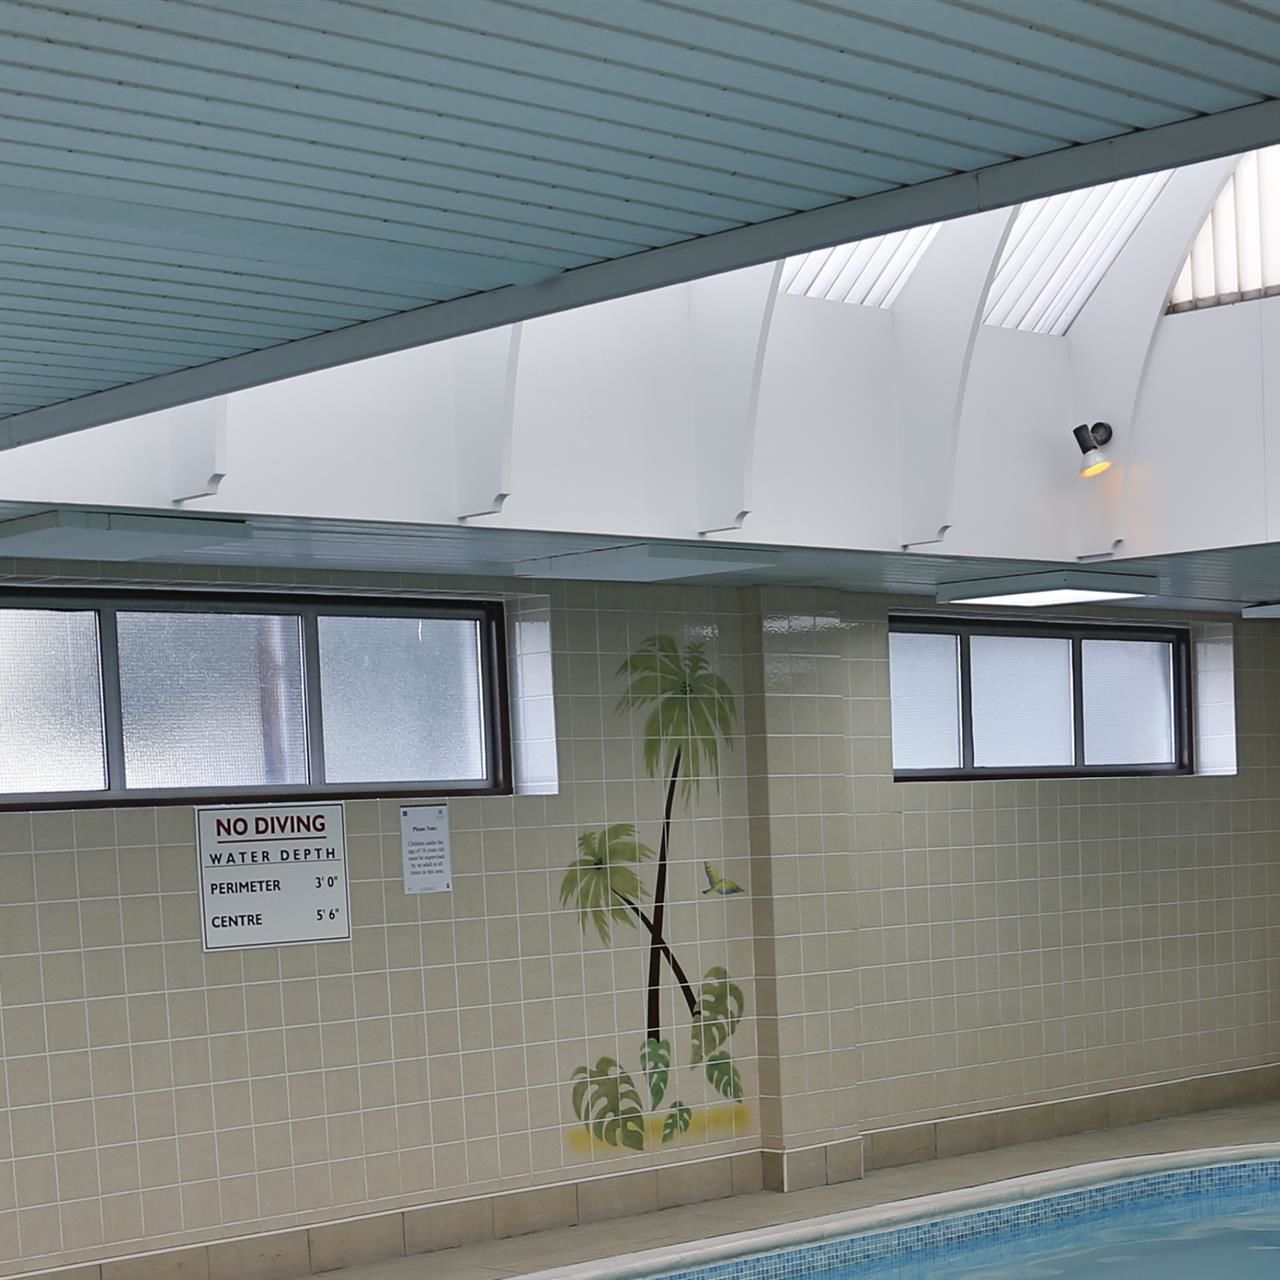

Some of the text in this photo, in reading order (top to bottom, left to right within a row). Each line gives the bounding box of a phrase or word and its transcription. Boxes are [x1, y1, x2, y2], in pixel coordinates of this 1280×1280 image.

[216, 814, 326, 836] NO DIVING
[209, 848, 335, 865] WATER DEPTH
[210, 876, 338, 895] PERIMETER 3' 0"
[211, 908, 339, 928] CENTRE 5' 6"
